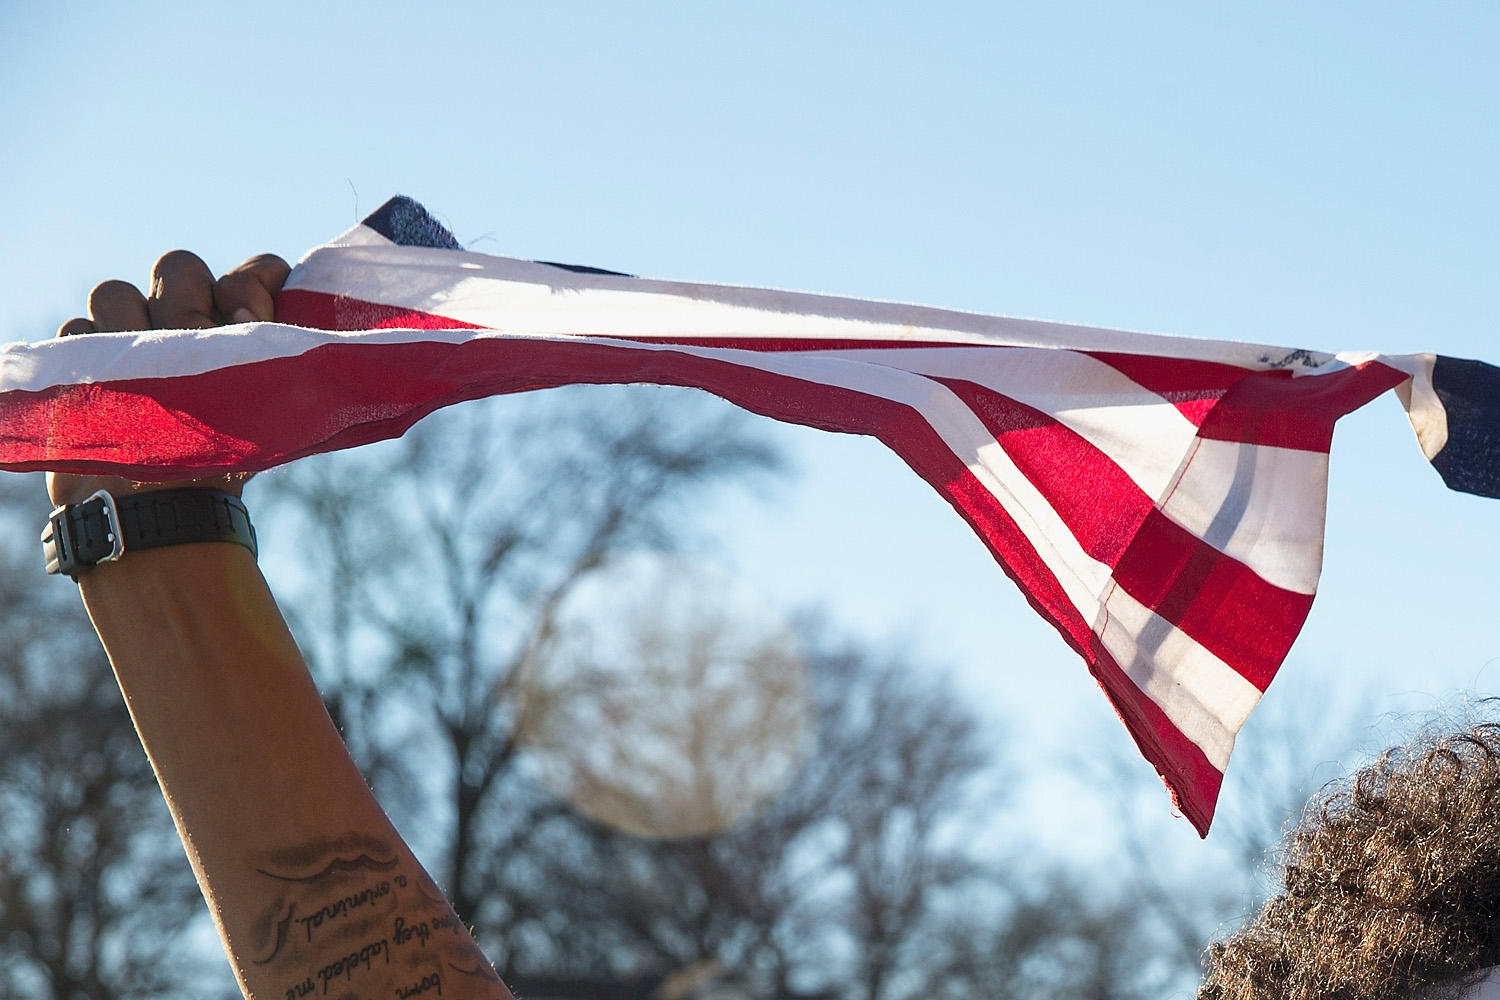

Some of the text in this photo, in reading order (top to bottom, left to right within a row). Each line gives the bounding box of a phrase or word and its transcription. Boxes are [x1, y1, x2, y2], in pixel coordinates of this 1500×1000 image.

[294, 875, 408, 943] a criminal.
[392, 917, 431, 948] they
[317, 939, 390, 996] labeled
[395, 972, 442, 1000] born
